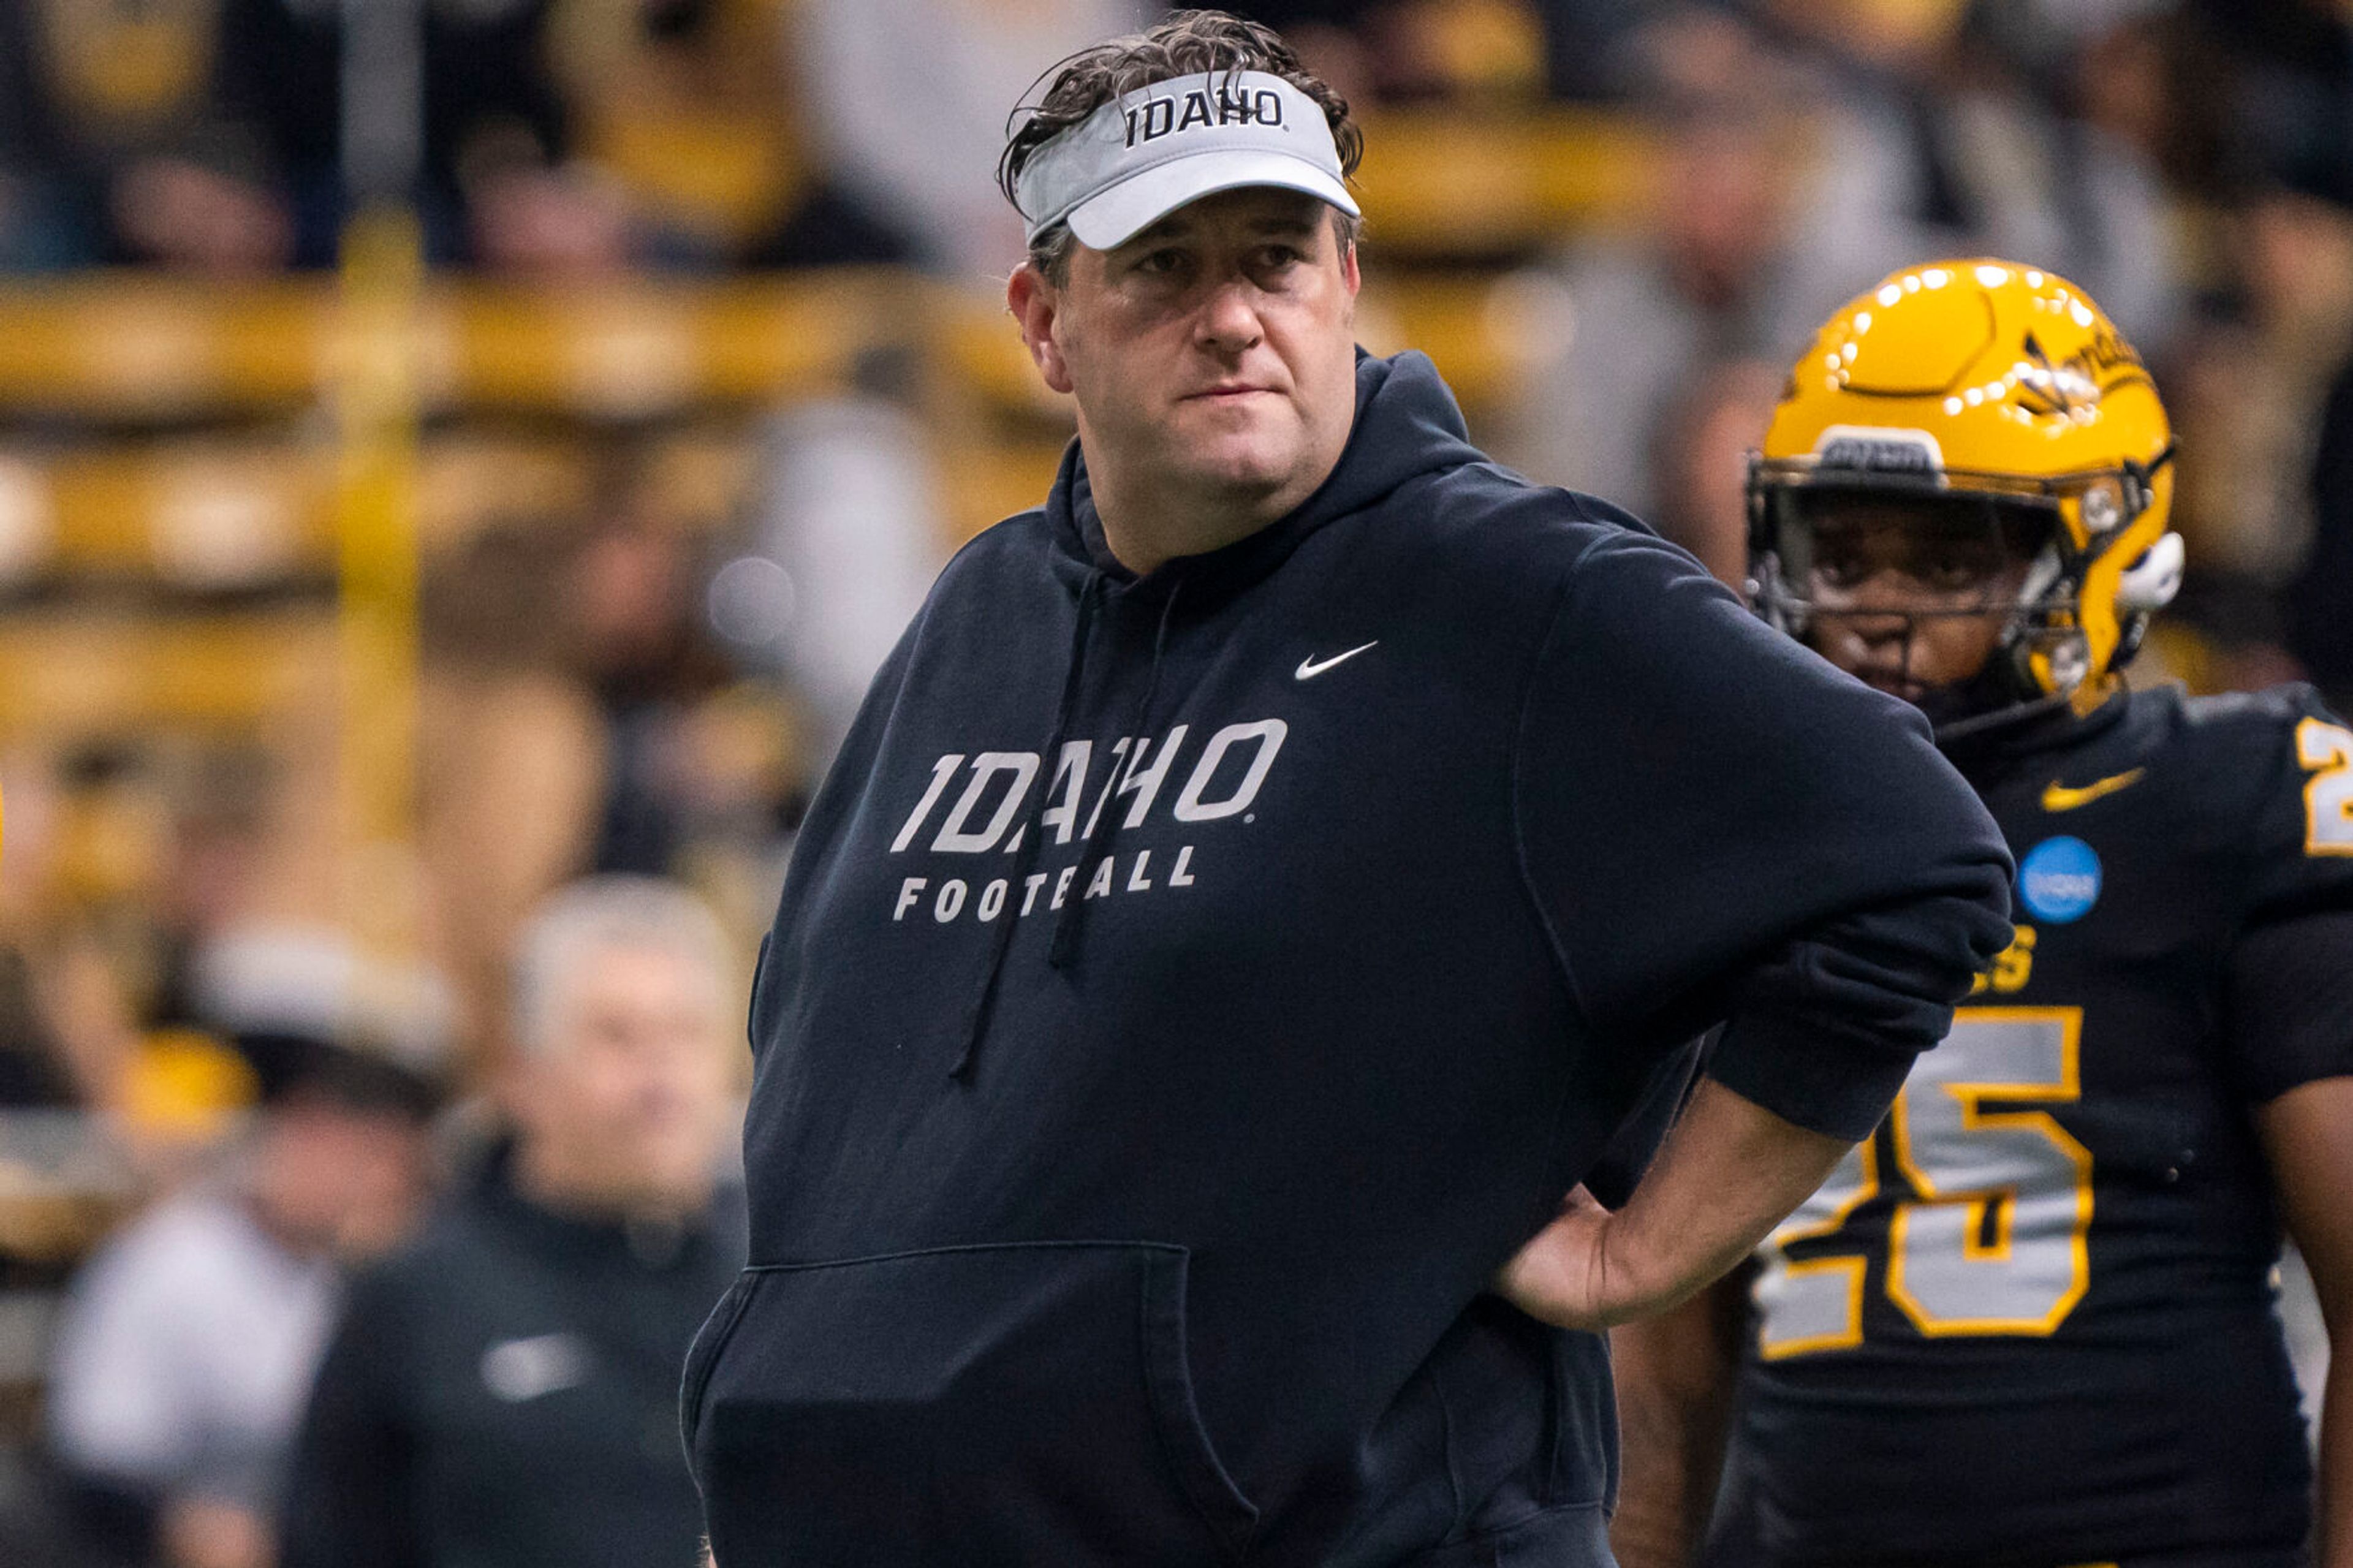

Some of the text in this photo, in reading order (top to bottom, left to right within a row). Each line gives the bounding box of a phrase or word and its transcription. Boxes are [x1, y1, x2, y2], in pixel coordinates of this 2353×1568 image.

[1125, 86, 1283, 148] IDAHO
[889, 718, 1288, 853] IDAHO
[893, 846, 1195, 923] FOOTBALL
